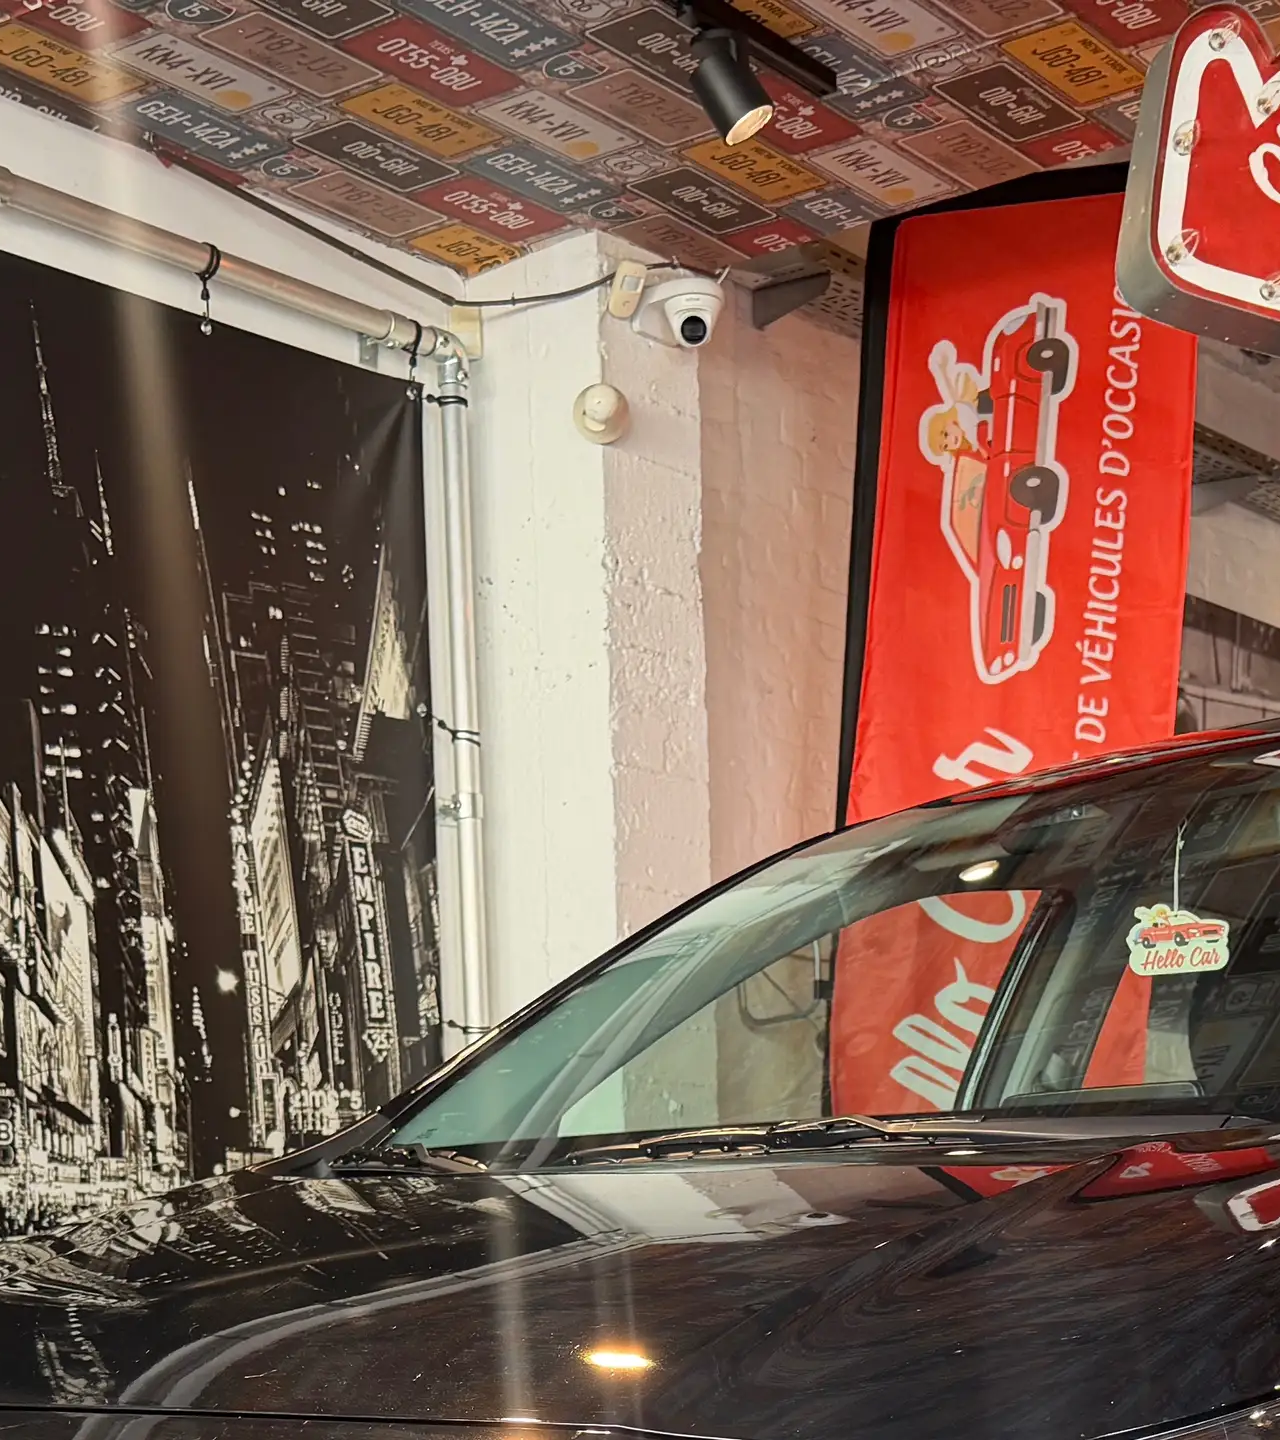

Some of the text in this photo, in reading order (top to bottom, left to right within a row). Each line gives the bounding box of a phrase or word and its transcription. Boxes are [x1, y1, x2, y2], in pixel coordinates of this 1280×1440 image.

[1073, 287, 1142, 745] DE VÉHICULES D'OCCASI
[350, 845, 386, 1020] EMPIRE
[1139, 946, 1222, 972] Hello Car
